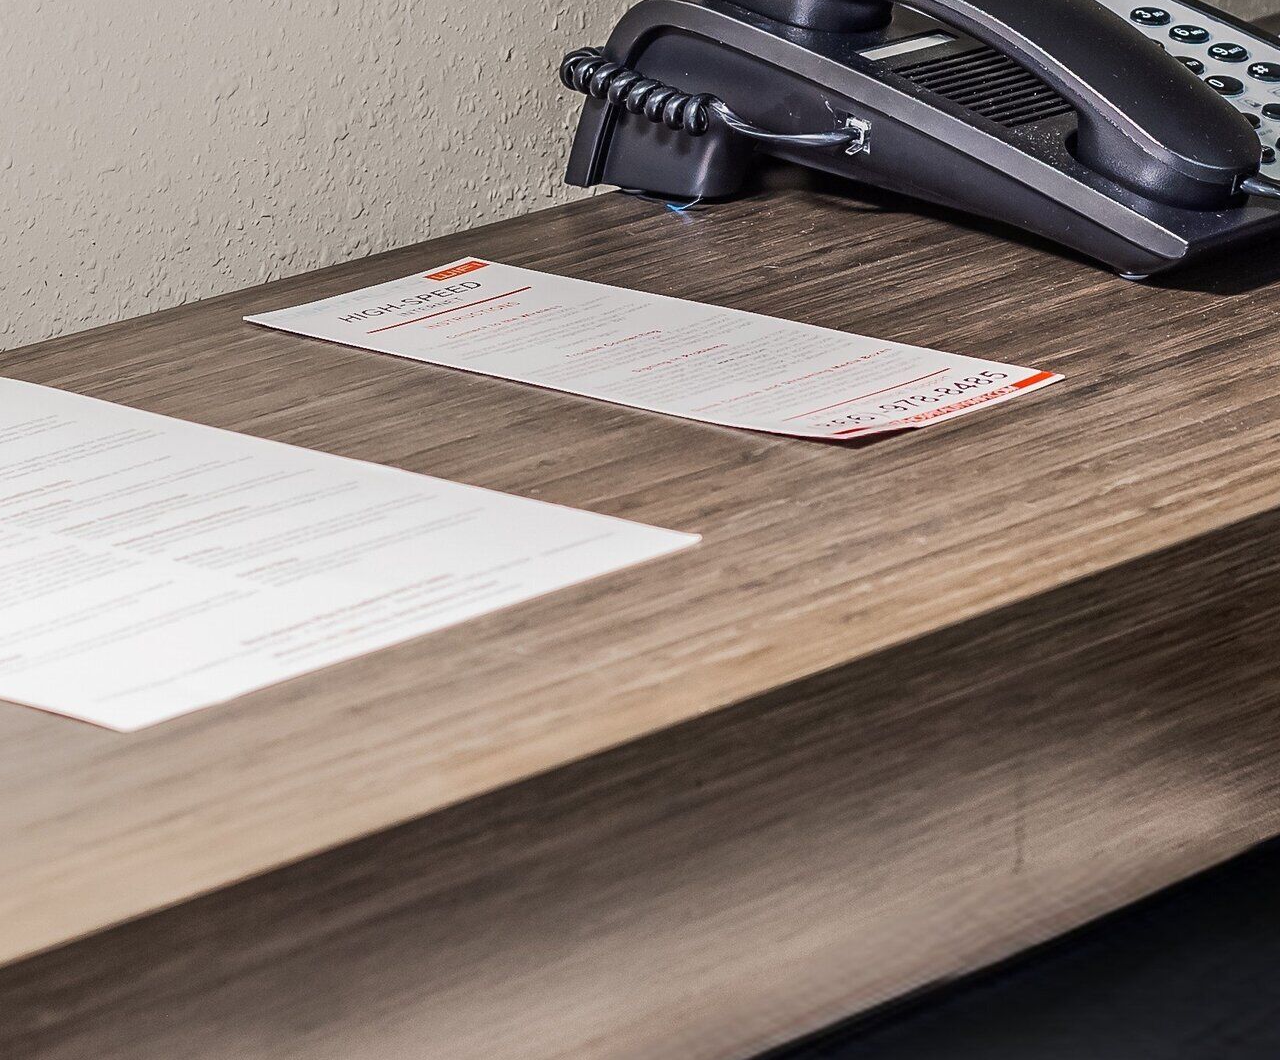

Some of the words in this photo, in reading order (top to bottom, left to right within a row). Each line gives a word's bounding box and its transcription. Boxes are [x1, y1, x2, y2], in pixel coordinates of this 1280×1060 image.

[1135, 9, 1152, 19] 3
[1173, 27, 1190, 37] 6
[1212, 46, 1229, 56] 9
[1208, 78, 1225, 88] 0
[337, 281, 482, 324] HIGH-SPEED
[397, 296, 463, 317] INTERNET
[427, 300, 521, 330] INSTRUCTIONS
